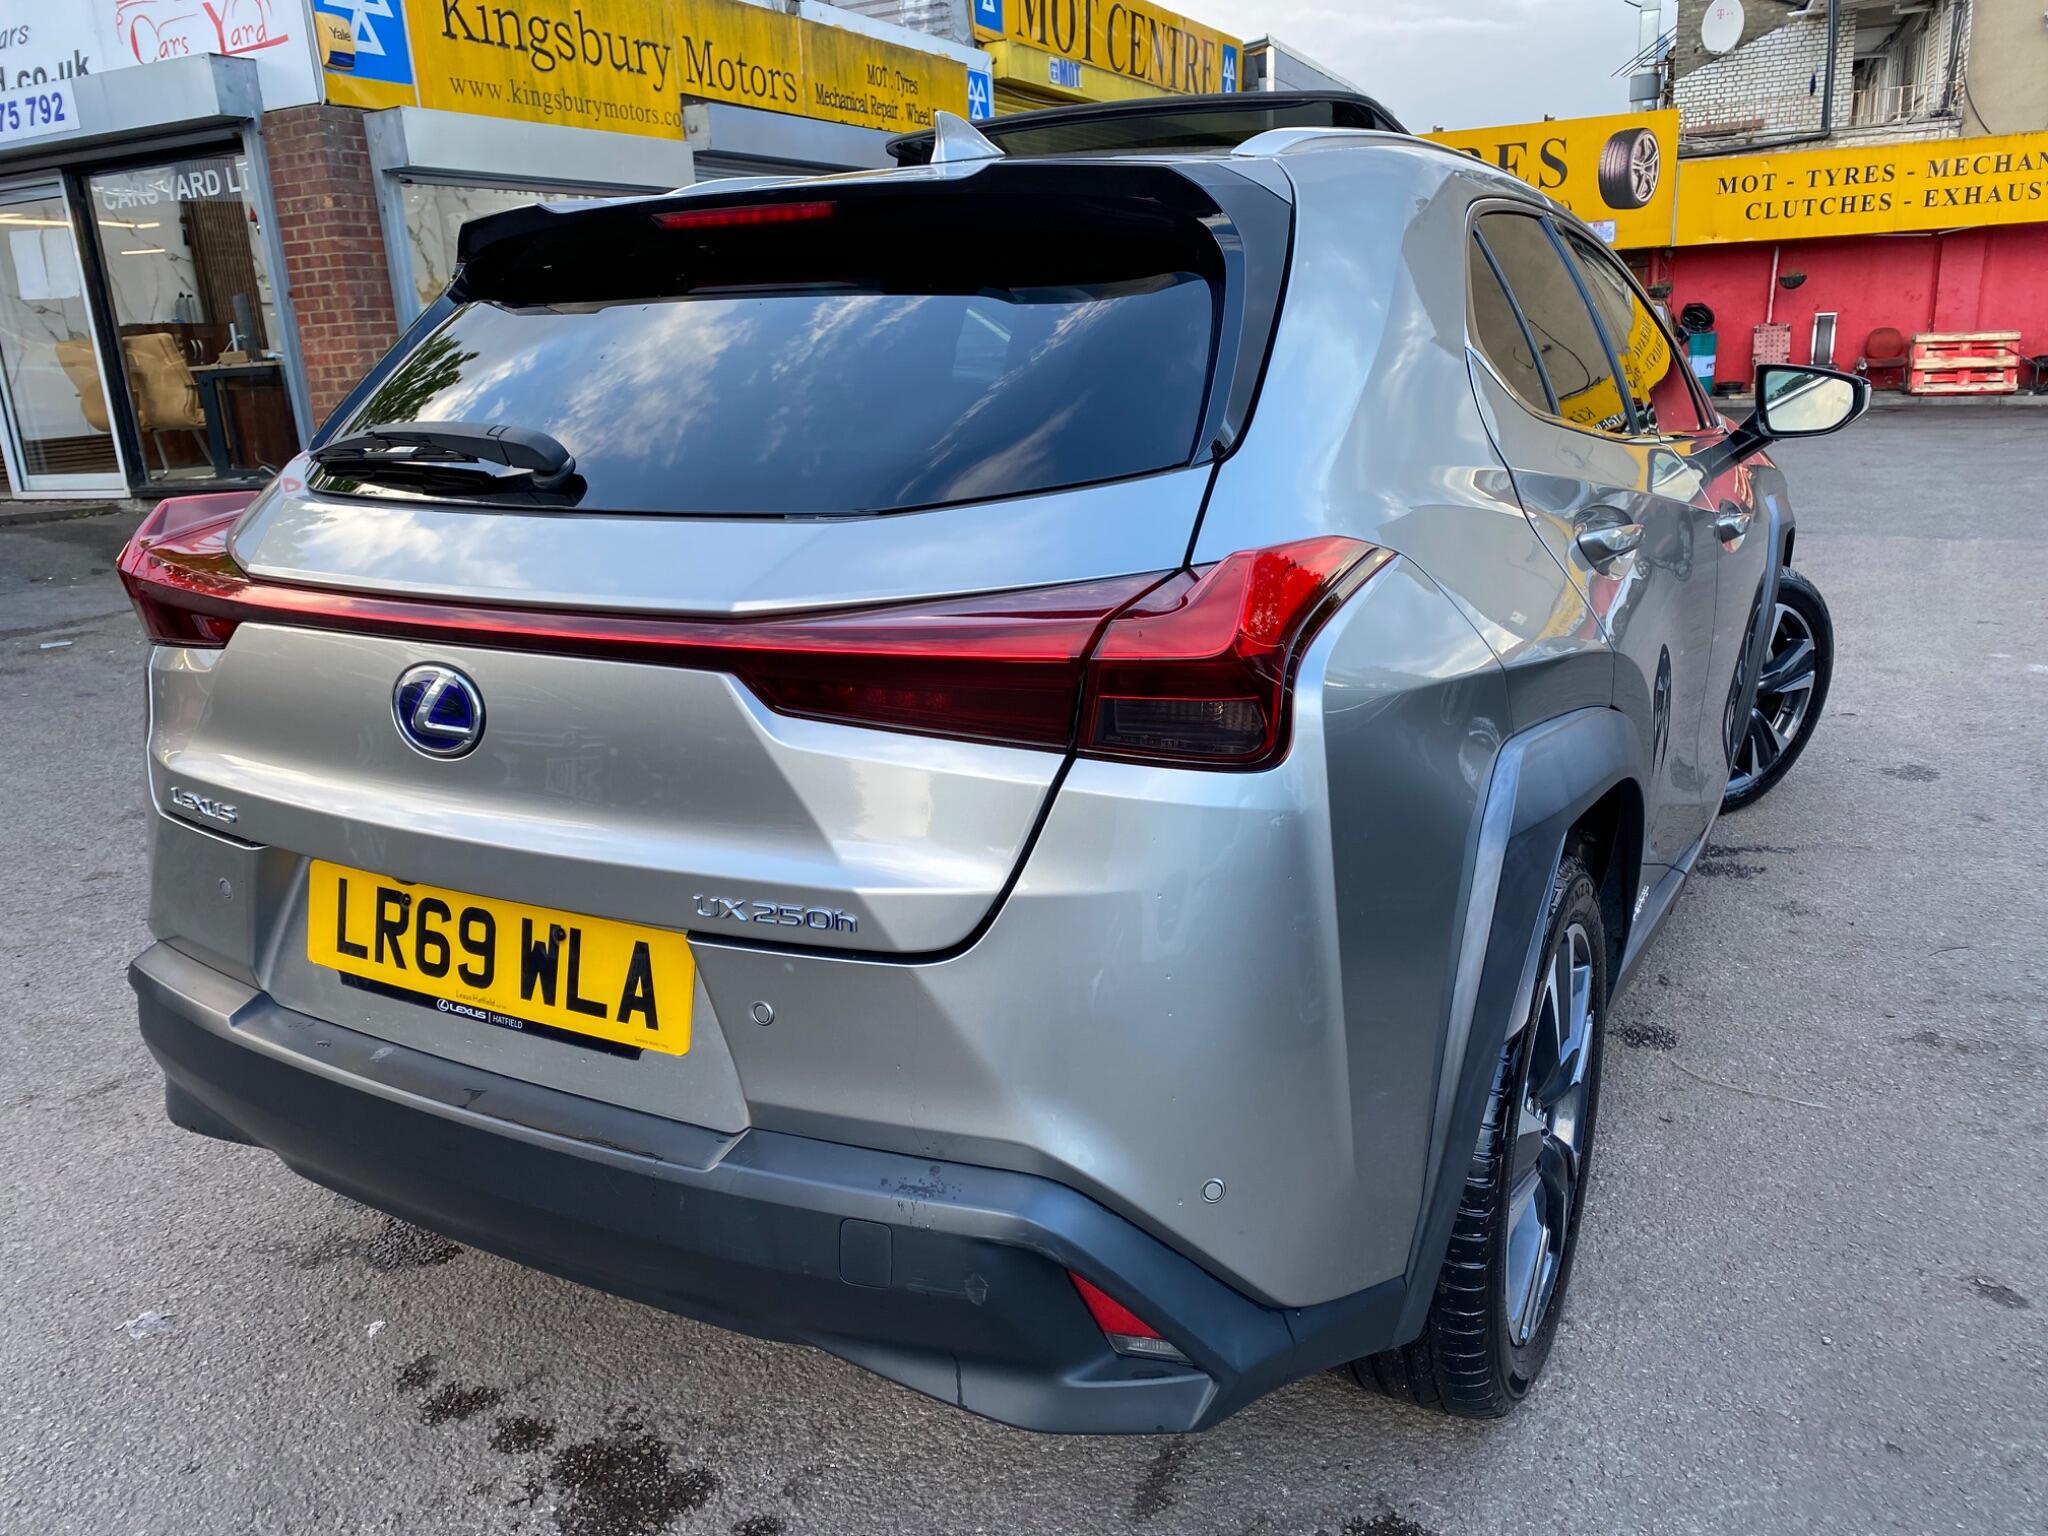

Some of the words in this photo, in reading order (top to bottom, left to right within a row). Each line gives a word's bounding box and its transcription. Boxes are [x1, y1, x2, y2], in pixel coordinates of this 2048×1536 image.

[130, 14, 190, 64] Cars
[329, 26, 351, 42] Yale
[442, 0, 671, 92] Kingsbury
[682, 35, 797, 103] Motors
[1016, 0, 1099, 62] MOT
[1107, 3, 1216, 95] CENTRE
[867, 64, 888, 88] MOT
[895, 71, 919, 97] Tyres
[25, 92, 65, 126] 792
[815, 83, 868, 114] Mechanical
[870, 95, 898, 123] Repair
[905, 103, 931, 126] Wheel
[101, 184, 158, 210] CARS
[164, 169, 220, 202] YARD
[1716, 173, 1777, 196] MOT
[1806, 163, 1896, 189] TYRES
[1745, 193, 1892, 221] CLUTCHES
[1923, 181, 2048, 208] EXHAUS
[170, 787, 237, 824] LEXUS
[693, 894, 749, 922] UX
[752, 900, 858, 933] 250h
[337, 877, 496, 990] LR69
[520, 917, 659, 1031] WLA
[449, 1003, 486, 1020] LEXUS
[493, 1014, 523, 1030] HATFIELD
